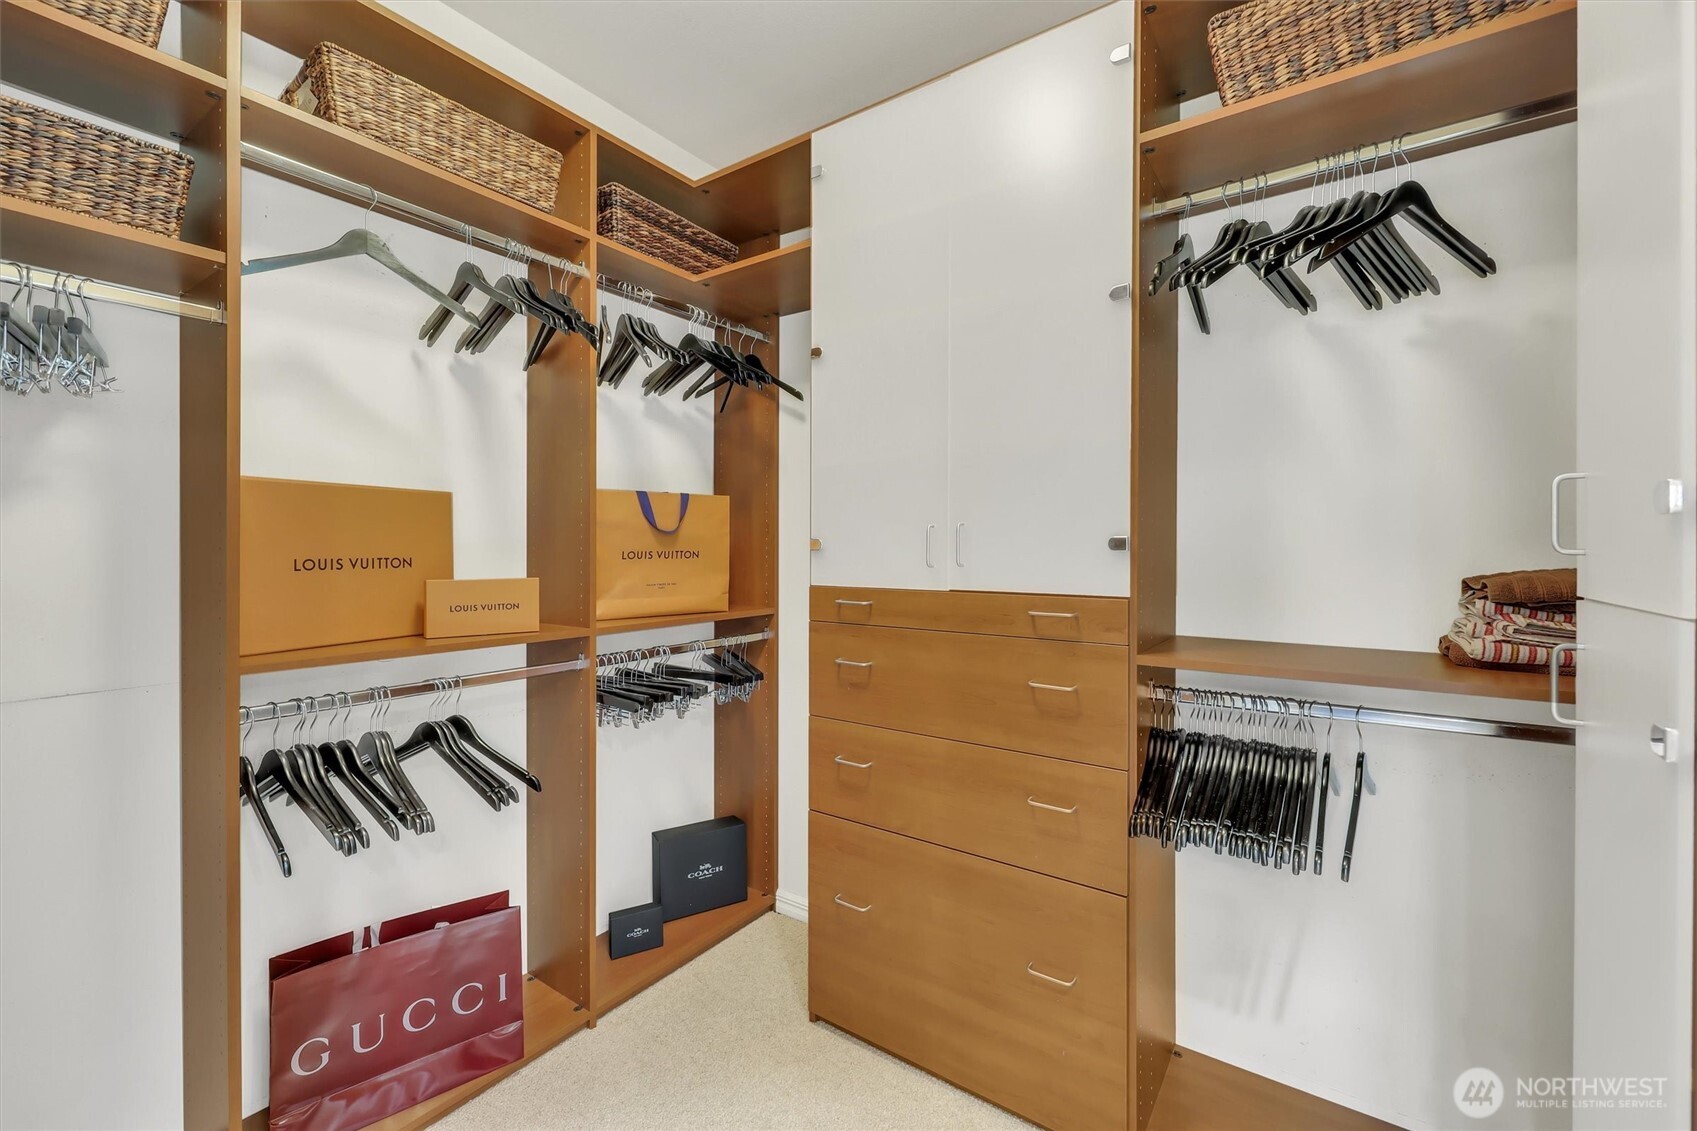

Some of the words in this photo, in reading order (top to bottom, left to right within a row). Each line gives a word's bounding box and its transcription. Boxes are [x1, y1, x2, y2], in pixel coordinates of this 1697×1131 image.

[621, 551, 654, 560] LOUIS
[656, 550, 700, 560] VUITTON
[293, 558, 344, 572] LOUIS
[348, 557, 413, 570] VUITTON
[449, 604, 479, 613] LOUIS
[480, 602, 520, 611] VUITTON
[687, 865, 724, 879] COACH
[626, 928, 649, 938] COACH
[290, 972, 508, 1077] GUCCI
